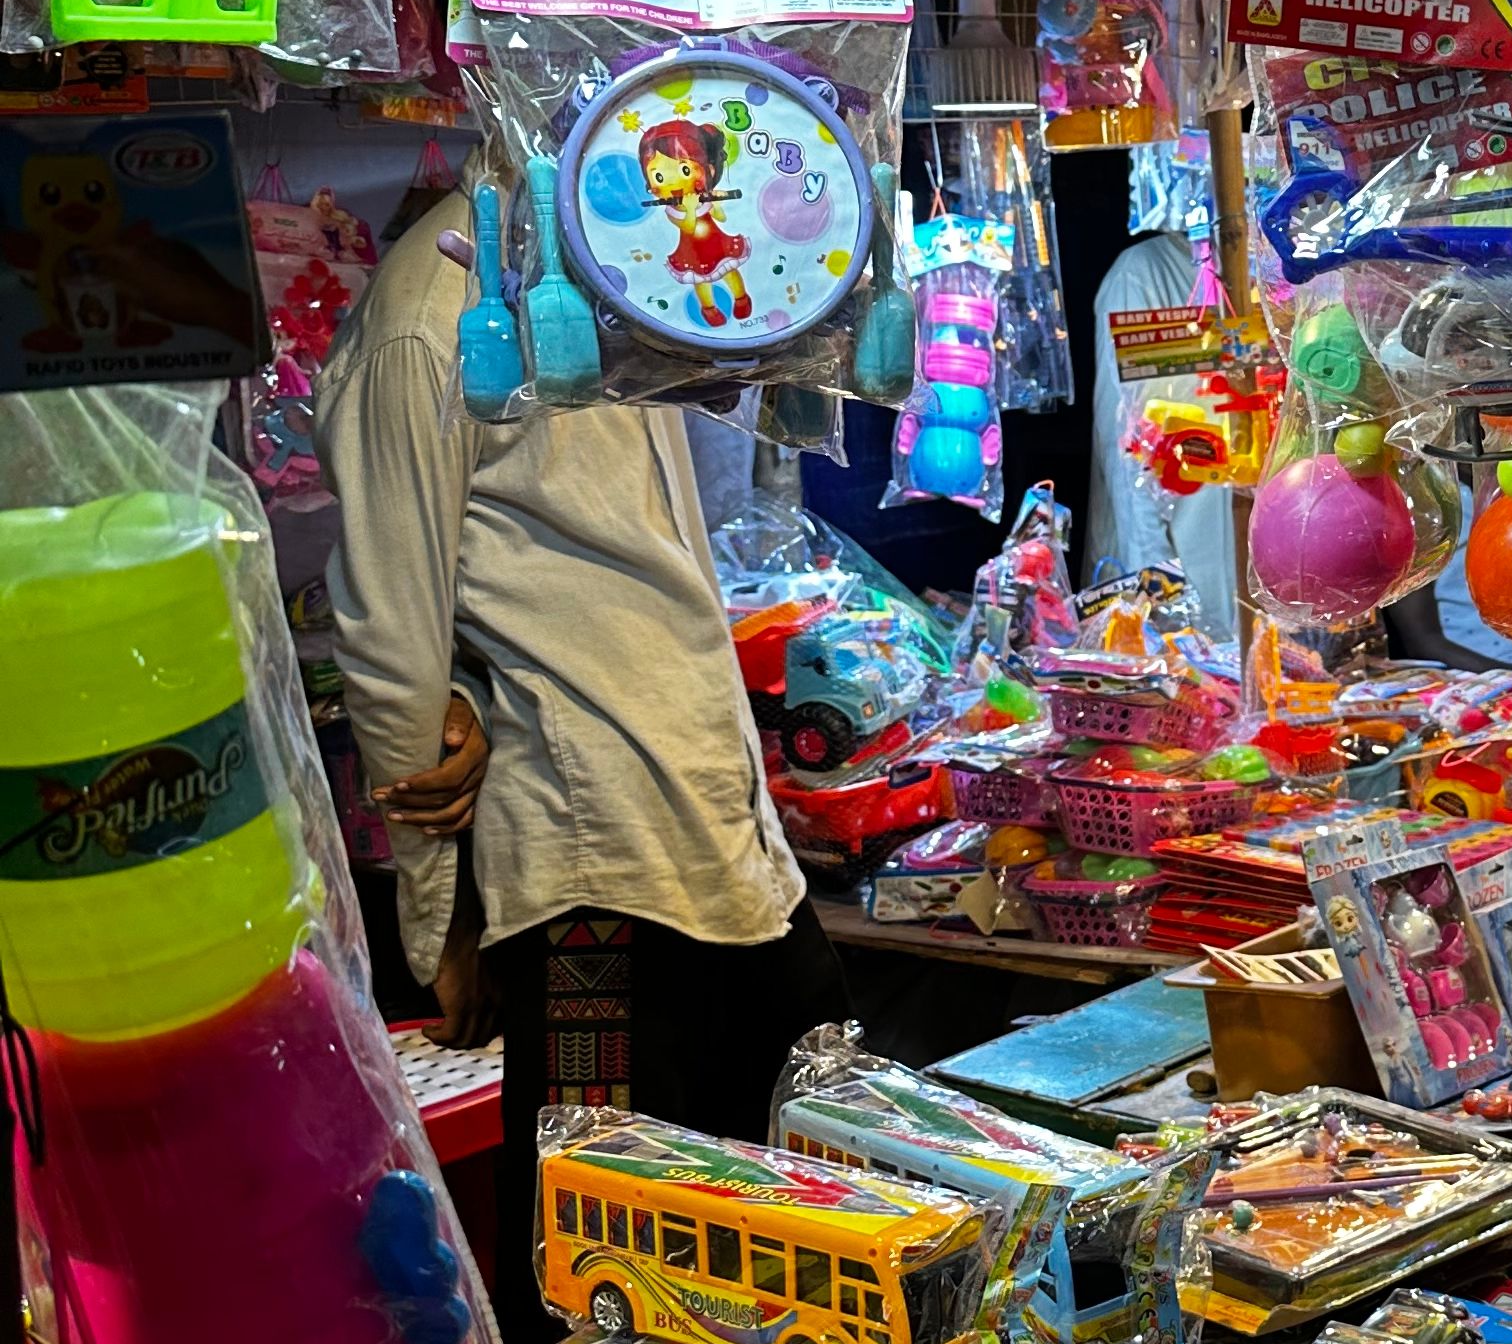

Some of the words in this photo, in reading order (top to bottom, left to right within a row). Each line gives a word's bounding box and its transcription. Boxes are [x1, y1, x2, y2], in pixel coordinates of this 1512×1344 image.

[501, 0, 527, 9] BEST
[528, 2, 579, 11] WELCOME
[579, 3, 609, 11] GIFTS
[40, 737, 243, 865] Purified
[1469, 880, 1507, 906] ROZEN
[663, 1167, 707, 1186] BUS
[708, 1175, 802, 1207] TOURIST
[676, 1288, 765, 1330] TOURIST
[652, 1310, 693, 1336] BUS
